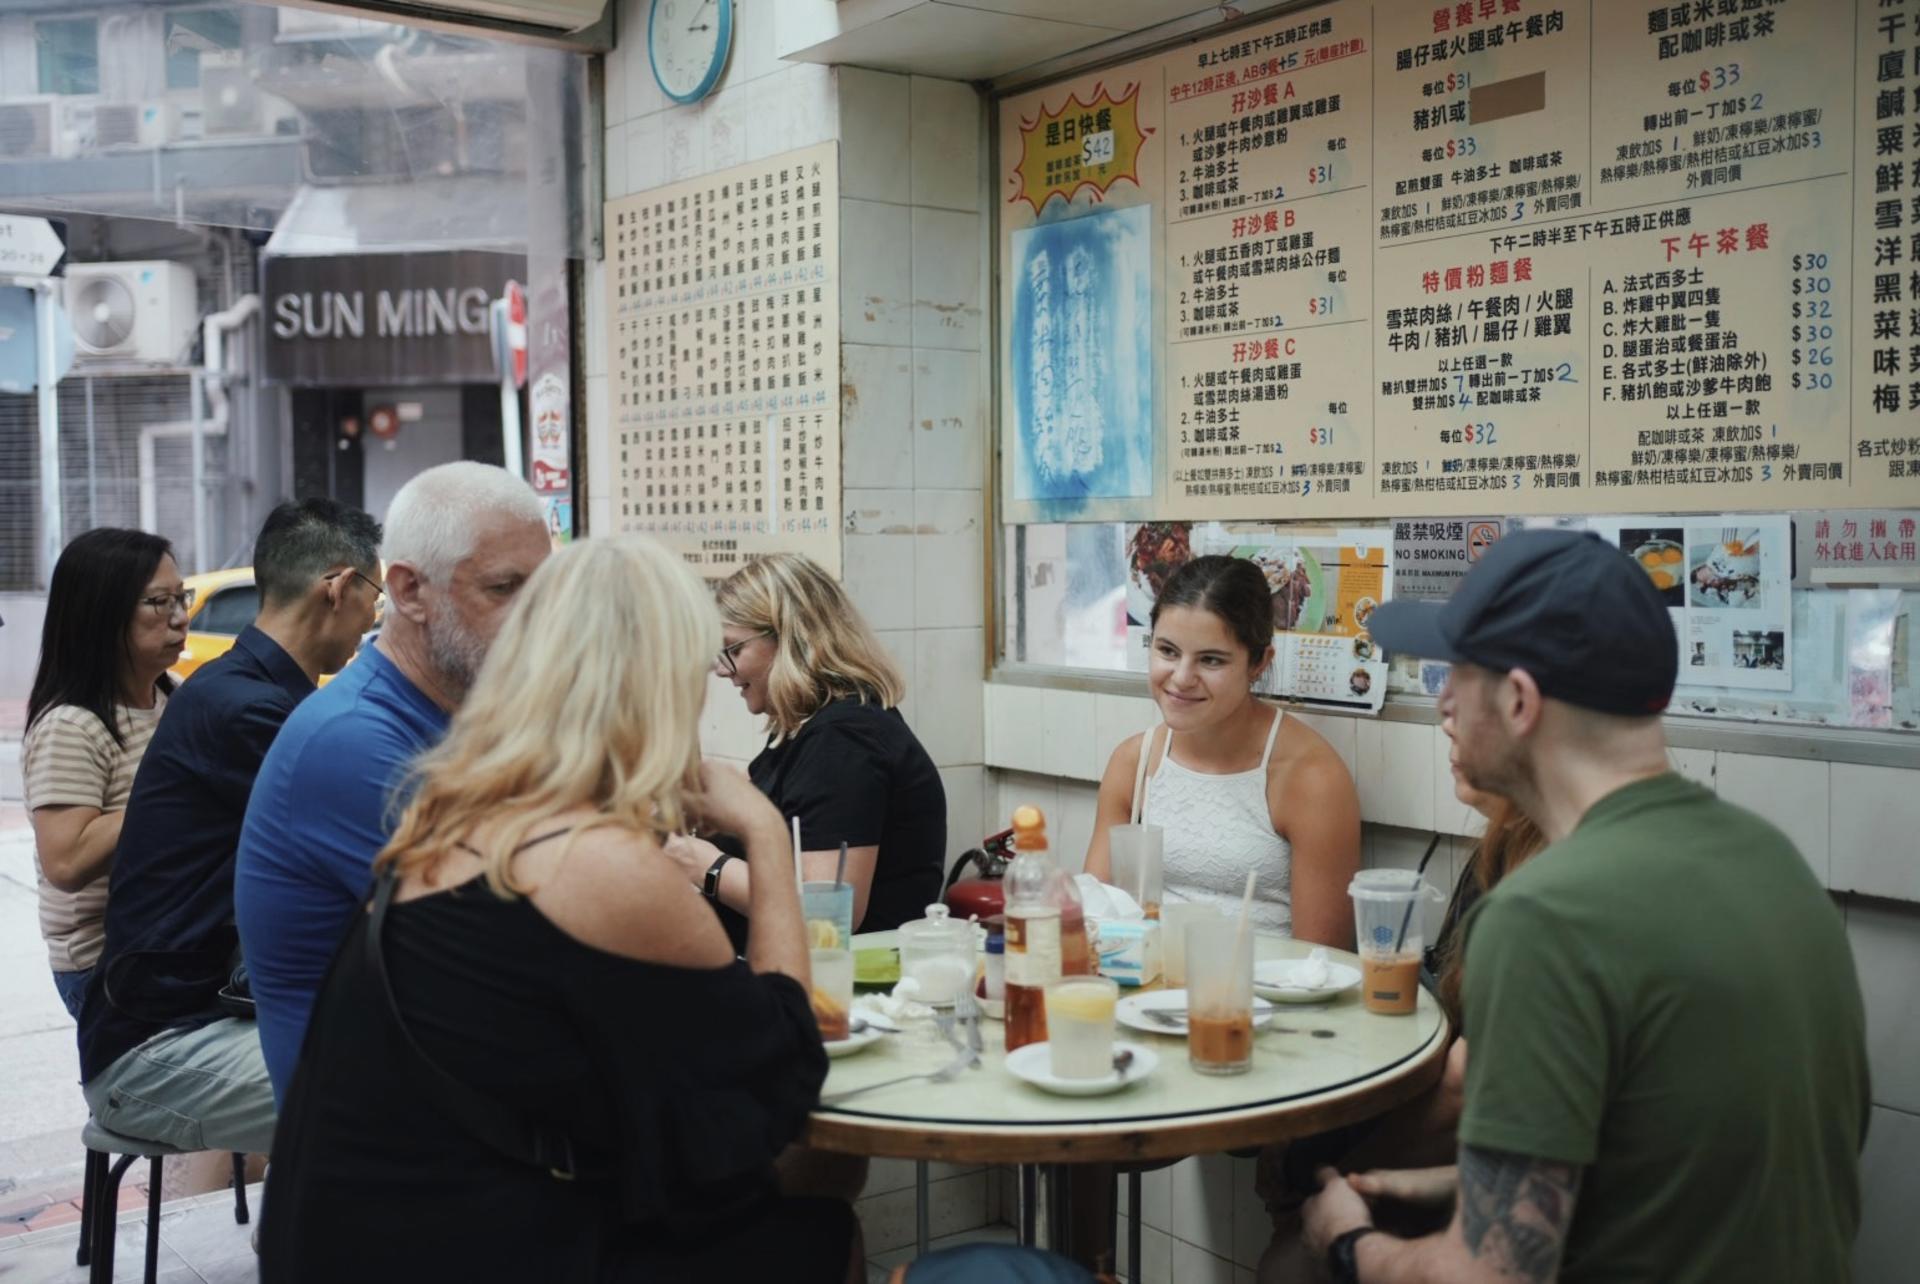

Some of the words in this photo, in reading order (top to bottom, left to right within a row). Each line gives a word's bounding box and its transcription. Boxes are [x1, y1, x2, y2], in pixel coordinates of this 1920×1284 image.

[1198, 18, 1332, 68] 早上七時至下午五時正供應
[1396, 10, 1564, 71] 腸仔或火腿或午餐肉
[1658, 11, 1775, 60] 配咖啡或茶
[1284, 81, 1295, 99] A
[1046, 108, 1111, 147] 是日快餐
[1327, 137, 1346, 151] 每位
[1193, 161, 1239, 182] 牛油多士
[1309, 164, 1332, 184] $31
[1686, 164, 1742, 189] 外賣同價
[1193, 178, 1239, 200] 咖啡或茶
[1284, 210, 1295, 227] B
[1490, 205, 1691, 253] 下午二時半至下午五時正供應
[1661, 222, 1769, 262] 下午茶餐
[1328, 270, 1347, 283] 每位
[1422, 257, 1533, 294] 特價粉麵餐
[1623, 267, 1704, 293] 法式西多士
[1193, 283, 1239, 304] 牛油多士
[1623, 287, 1721, 315] 炸雞中翼四隻
[274, 292, 364, 339] SUN
[378, 287, 489, 337] MING
[1193, 301, 1239, 321] 咖啡或茶
[1309, 296, 1333, 315] $31
[1285, 338, 1296, 356] C
[1623, 331, 1738, 358] 腿蛋治或餐蛋治
[1439, 352, 1513, 373] 以上任選一款
[1194, 407, 1240, 424] 牛油多士
[1328, 401, 1347, 415] 每位
[1666, 400, 1760, 420] 以上任選一款
[1194, 426, 1240, 443] 咖啡或茶
[1310, 427, 1333, 445] $31
[1638, 428, 1705, 447] 配咖啡或茶
[1395, 522, 1463, 541] 嚴禁吸煙
[1395, 549, 1411, 560] NO
[1414, 549, 1465, 560] SMOKING
[1815, 541, 1916, 561] 外食進入食用
